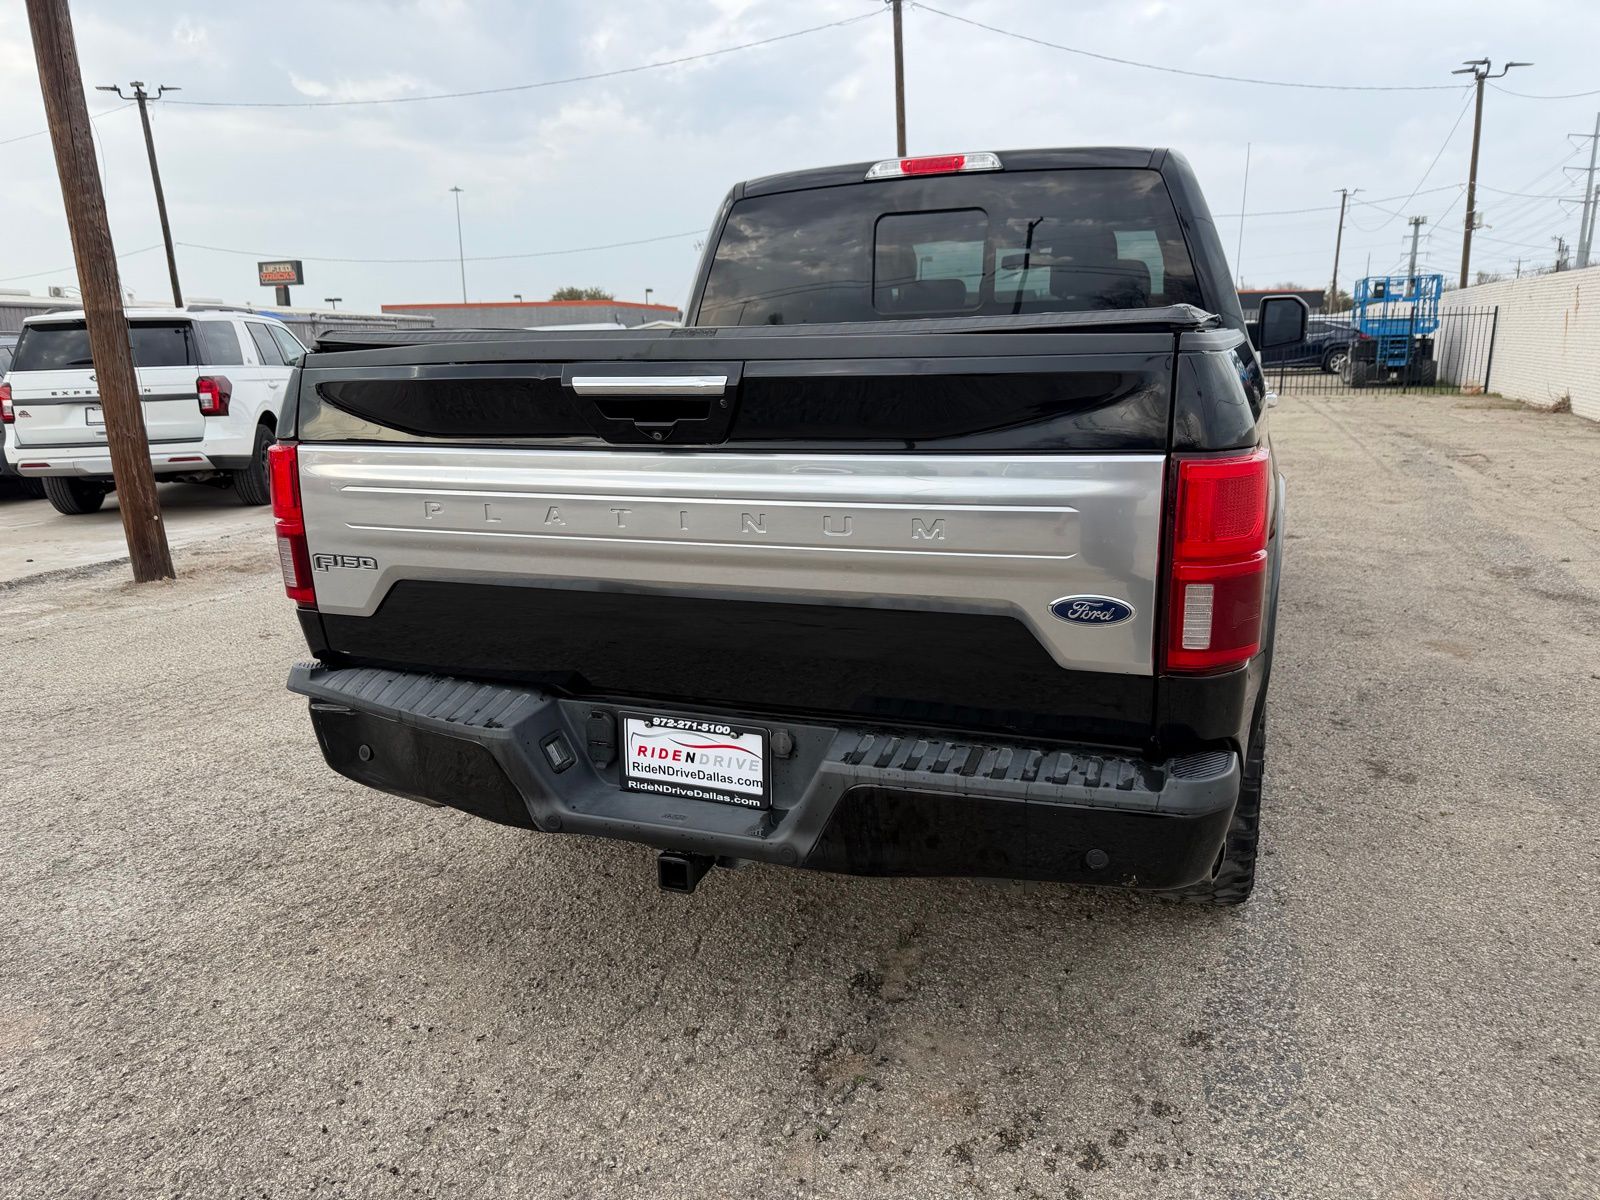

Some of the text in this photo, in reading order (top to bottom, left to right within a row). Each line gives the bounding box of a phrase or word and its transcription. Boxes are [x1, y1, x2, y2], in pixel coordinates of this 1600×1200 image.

[260, 271, 296, 281] TRUCKS
[424, 501, 946, 540] PLATINUM
[1067, 601, 1115, 621] Ford
[652, 717, 731, 735] 972-271-5100
[632, 761, 763, 789] RideNDriveDallas.com
[628, 780, 761, 807] RideNDriveDallas.com
